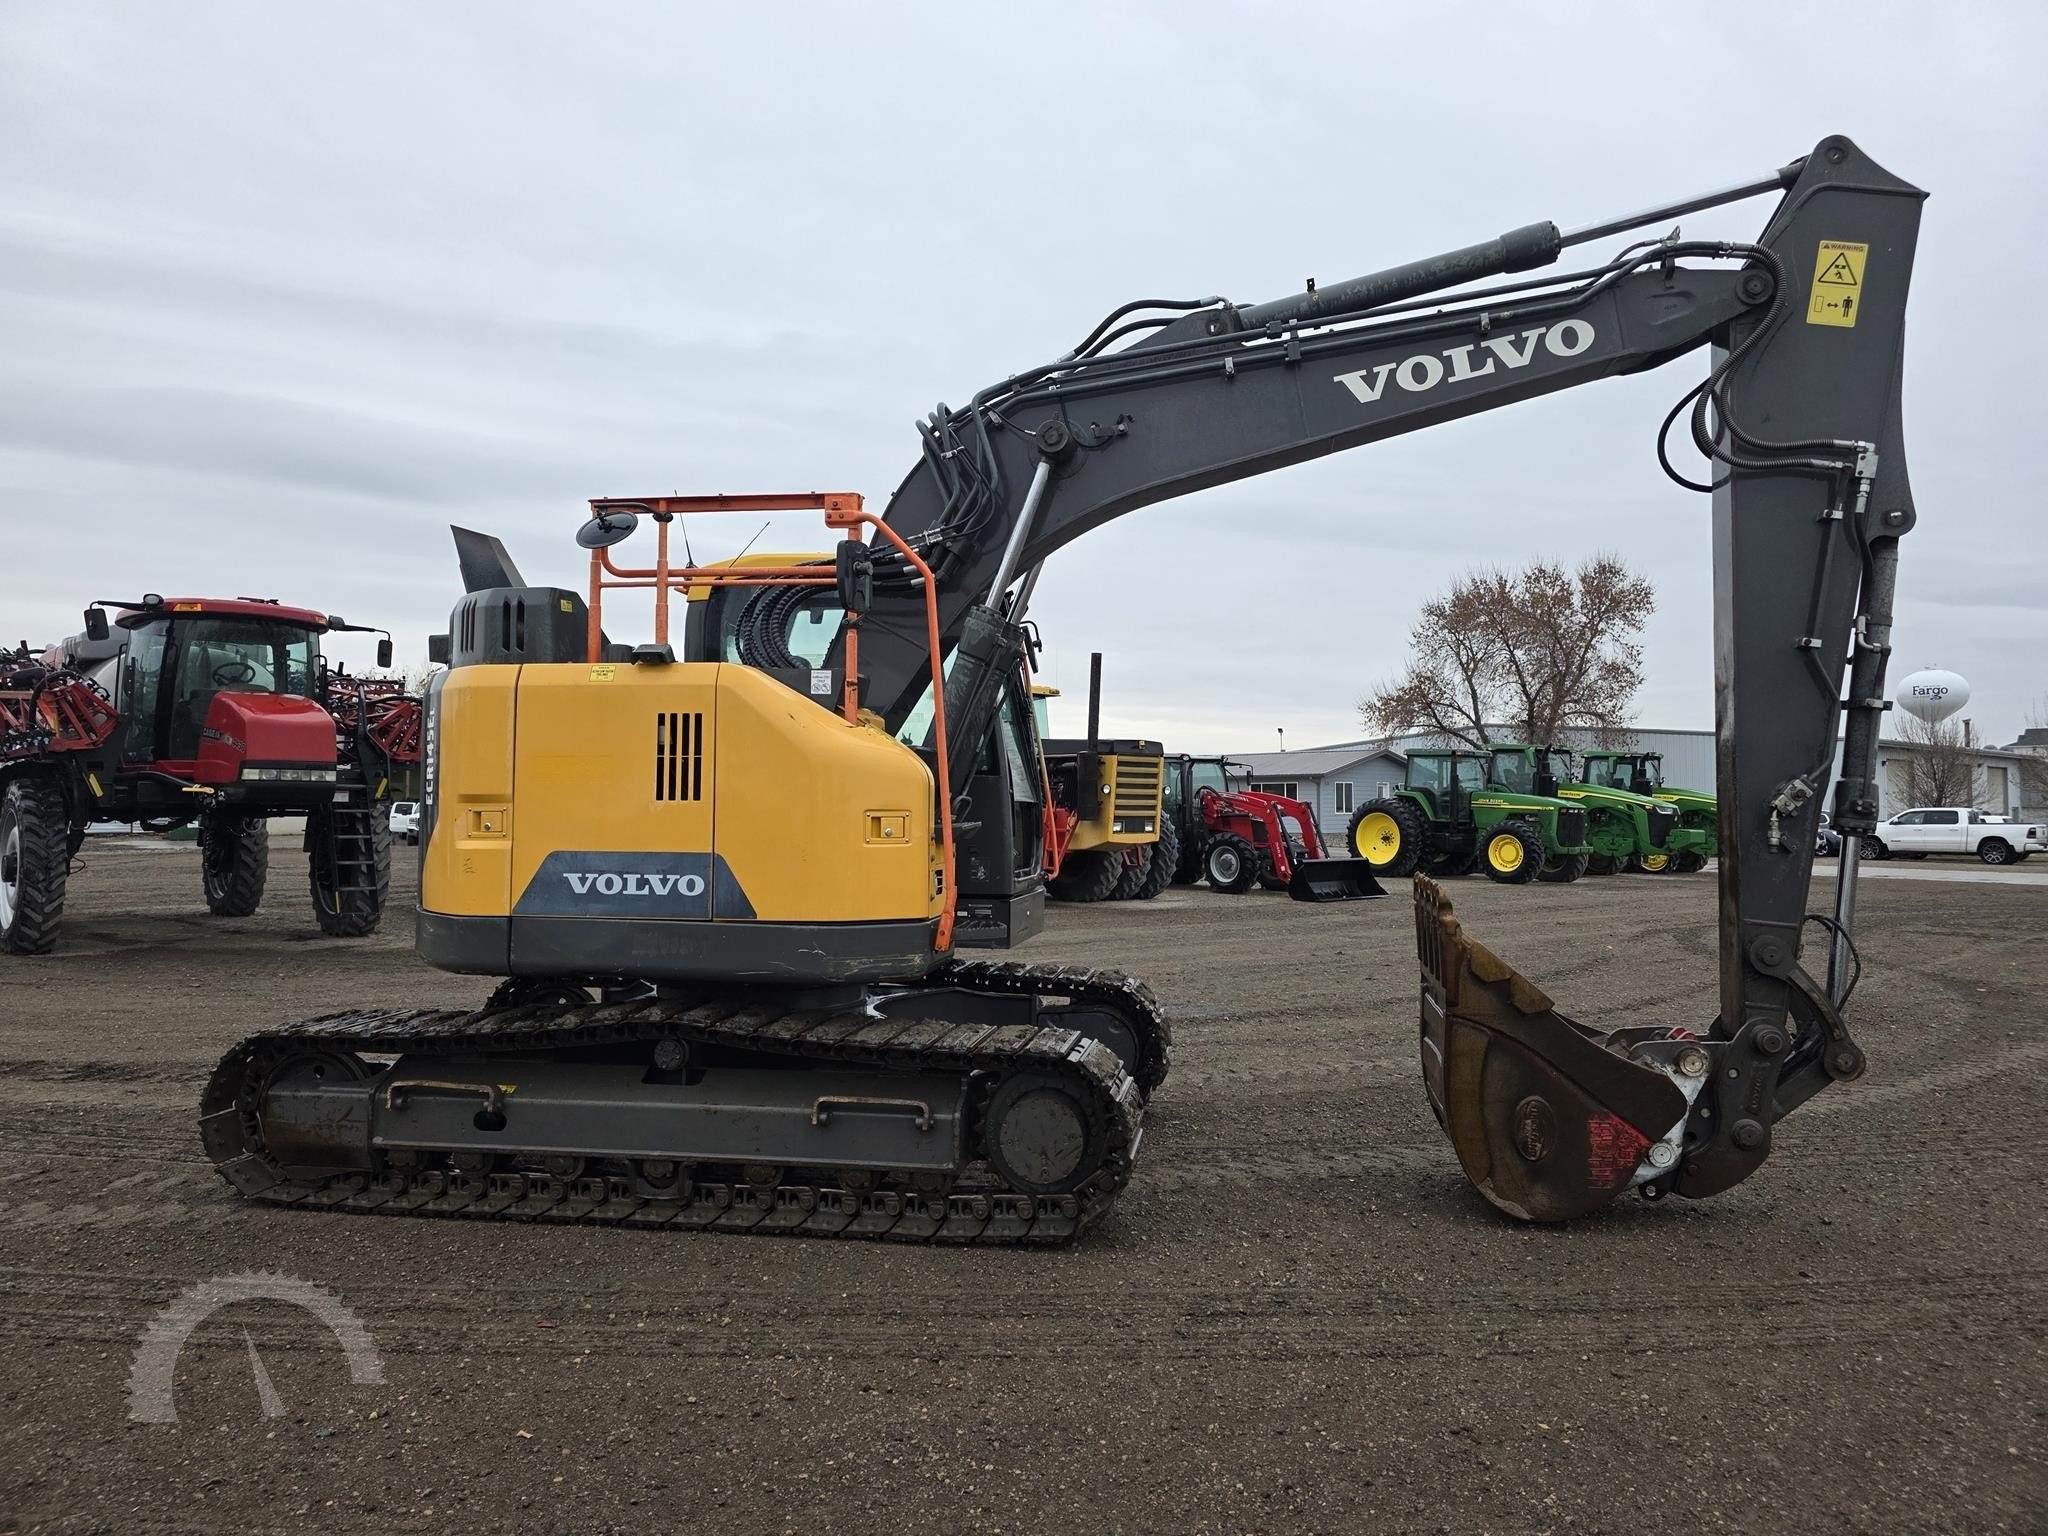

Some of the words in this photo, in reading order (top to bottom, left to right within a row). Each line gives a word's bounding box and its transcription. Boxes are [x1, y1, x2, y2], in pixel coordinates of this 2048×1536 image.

[1830, 243, 1864, 252] WARNING
[1334, 319, 1595, 403] VOLVO
[1912, 685, 1949, 699] Fargo
[563, 873, 705, 896] VOLVO
